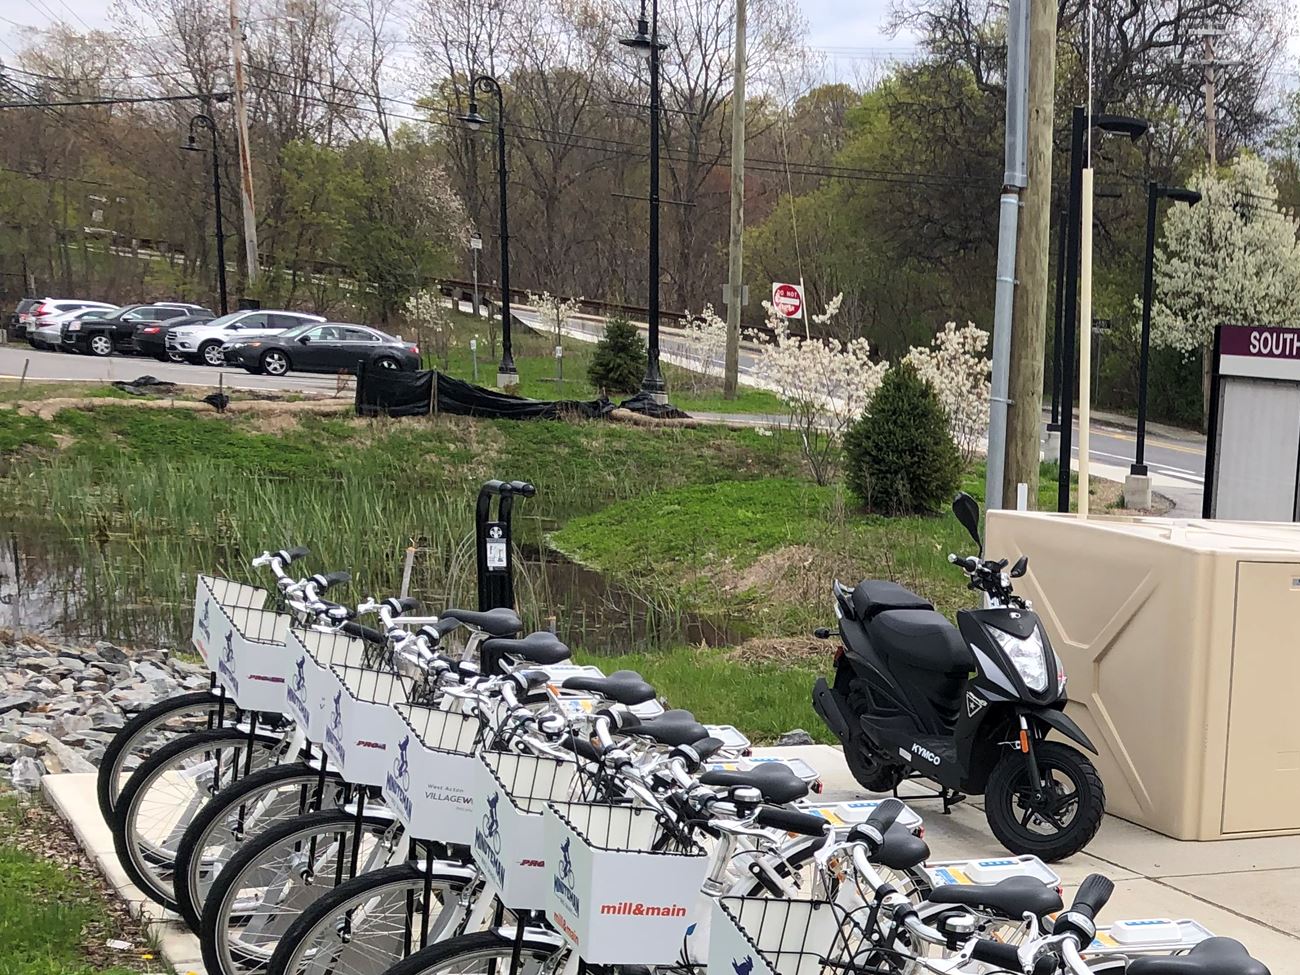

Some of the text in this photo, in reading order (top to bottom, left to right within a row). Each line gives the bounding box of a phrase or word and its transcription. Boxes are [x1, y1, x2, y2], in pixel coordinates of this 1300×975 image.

[911, 743, 940, 765] KYMCO
[425, 792, 473, 804] VILLAGEW
[600, 902, 687, 917] mill&main
